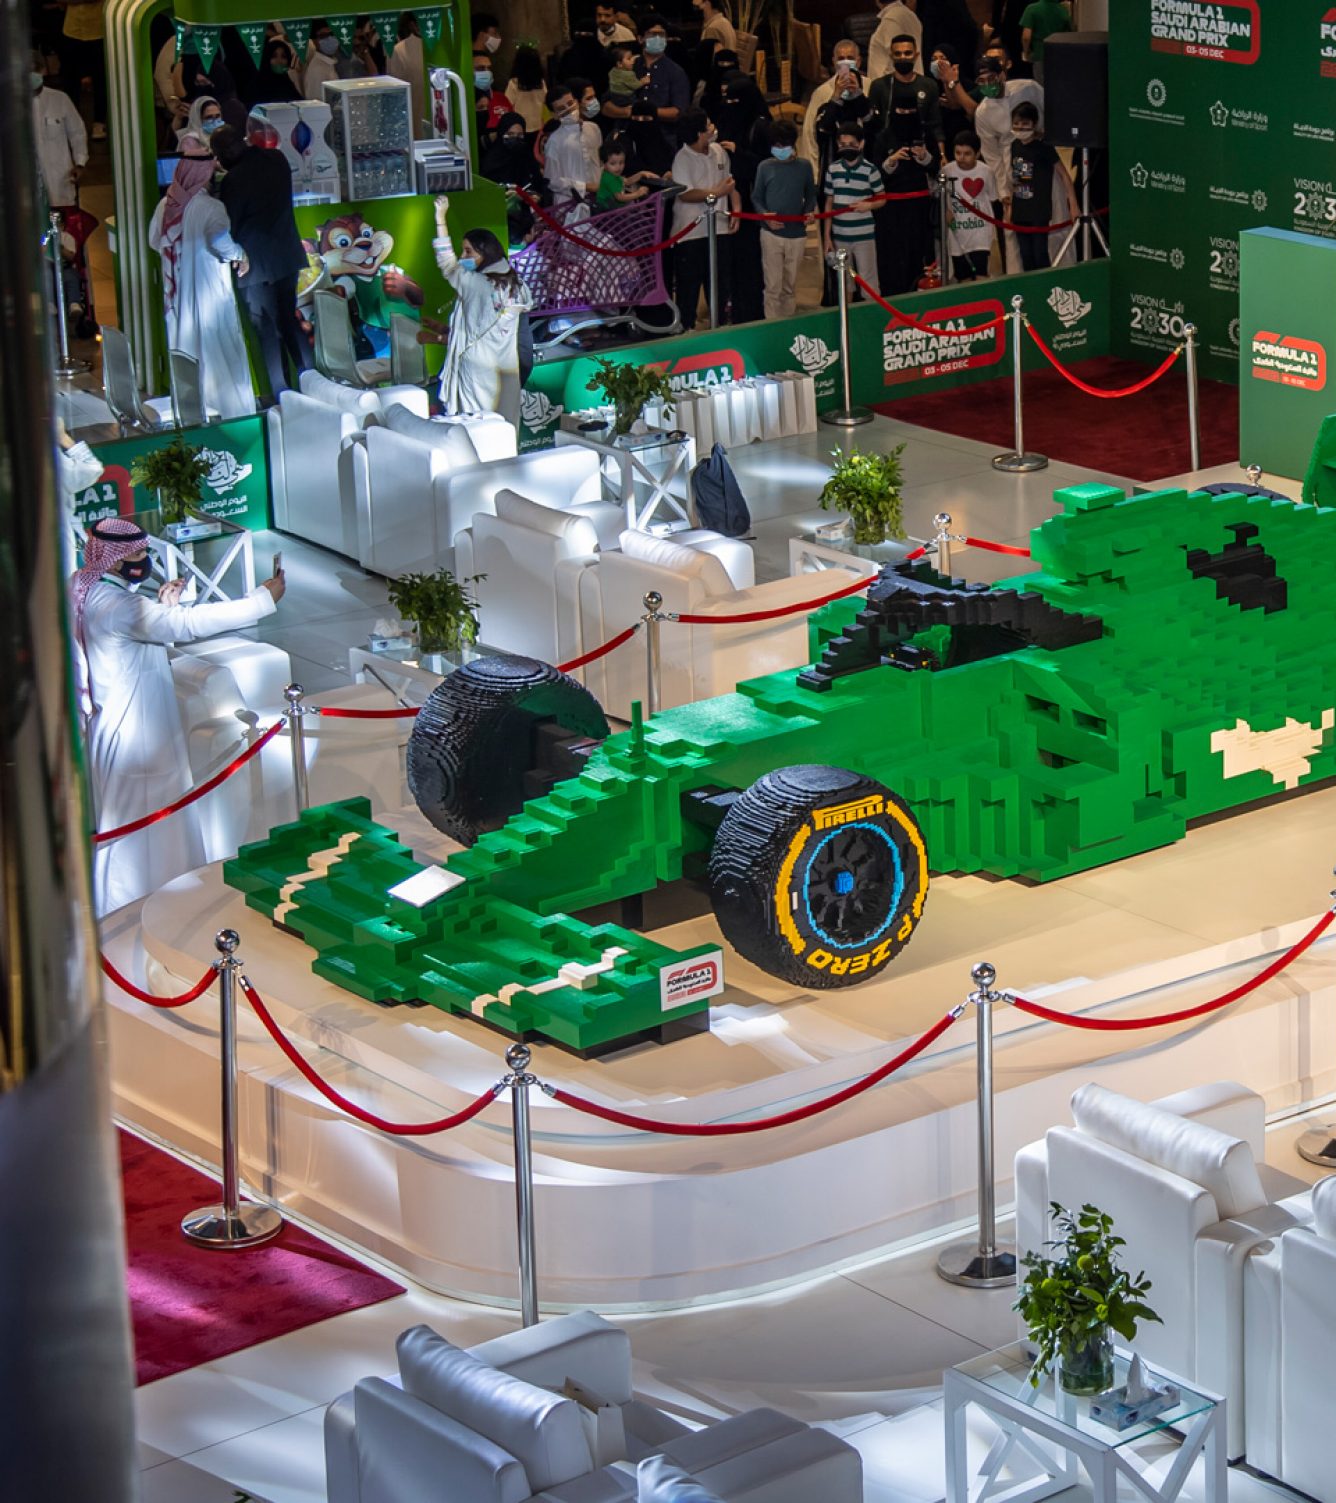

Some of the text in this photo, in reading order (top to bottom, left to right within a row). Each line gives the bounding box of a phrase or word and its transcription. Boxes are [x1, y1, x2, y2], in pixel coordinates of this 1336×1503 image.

[1151, 0, 1224, 20] FORMULA 1
[1151, 11, 1251, 37] SAUDI ARABIAN
[1151, 24, 1229, 47] GRAND PRIX
[1209, 49, 1225, 59] DEC
[1294, 178, 1324, 193] VISION
[1130, 292, 1158, 308] VISION
[883, 327, 995, 360] SAUDI ARABIAN
[1252, 340, 1309, 364] FORMULA
[1310, 353, 1318, 365] 1
[883, 343, 971, 371] GRAND PRIX
[953, 359, 969, 369] DEC
[720, 366, 731, 382] 1
[812, 794, 884, 831] PIRELLI
[807, 938, 892, 976] ZERO
[667, 970, 705, 987] FORMULA
